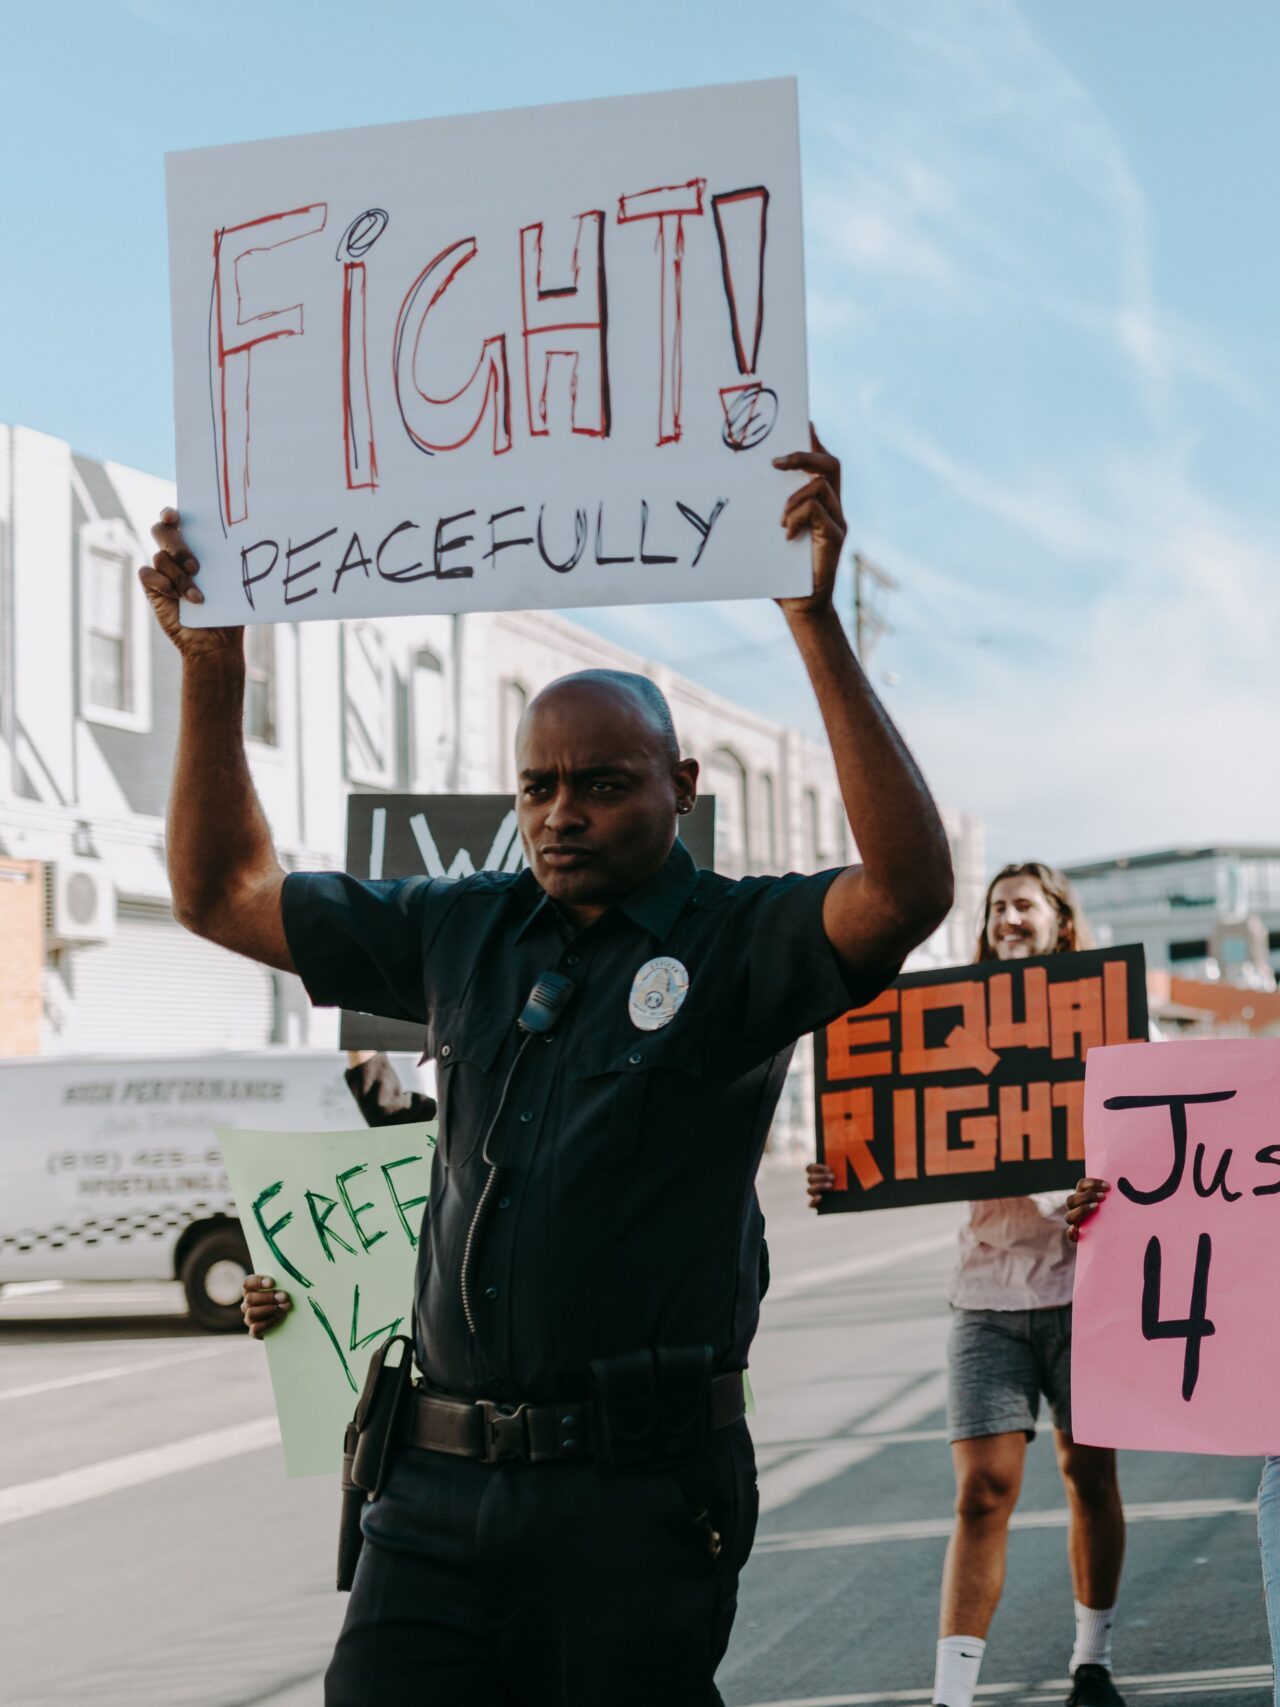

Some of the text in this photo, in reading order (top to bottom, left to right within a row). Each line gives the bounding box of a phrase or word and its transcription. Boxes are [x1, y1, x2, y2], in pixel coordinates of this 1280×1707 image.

[240, 499, 729, 610] PEACEFULLY
[825, 959, 1147, 1082] EQUAL
[1142, 1232, 1216, 1402] 4
